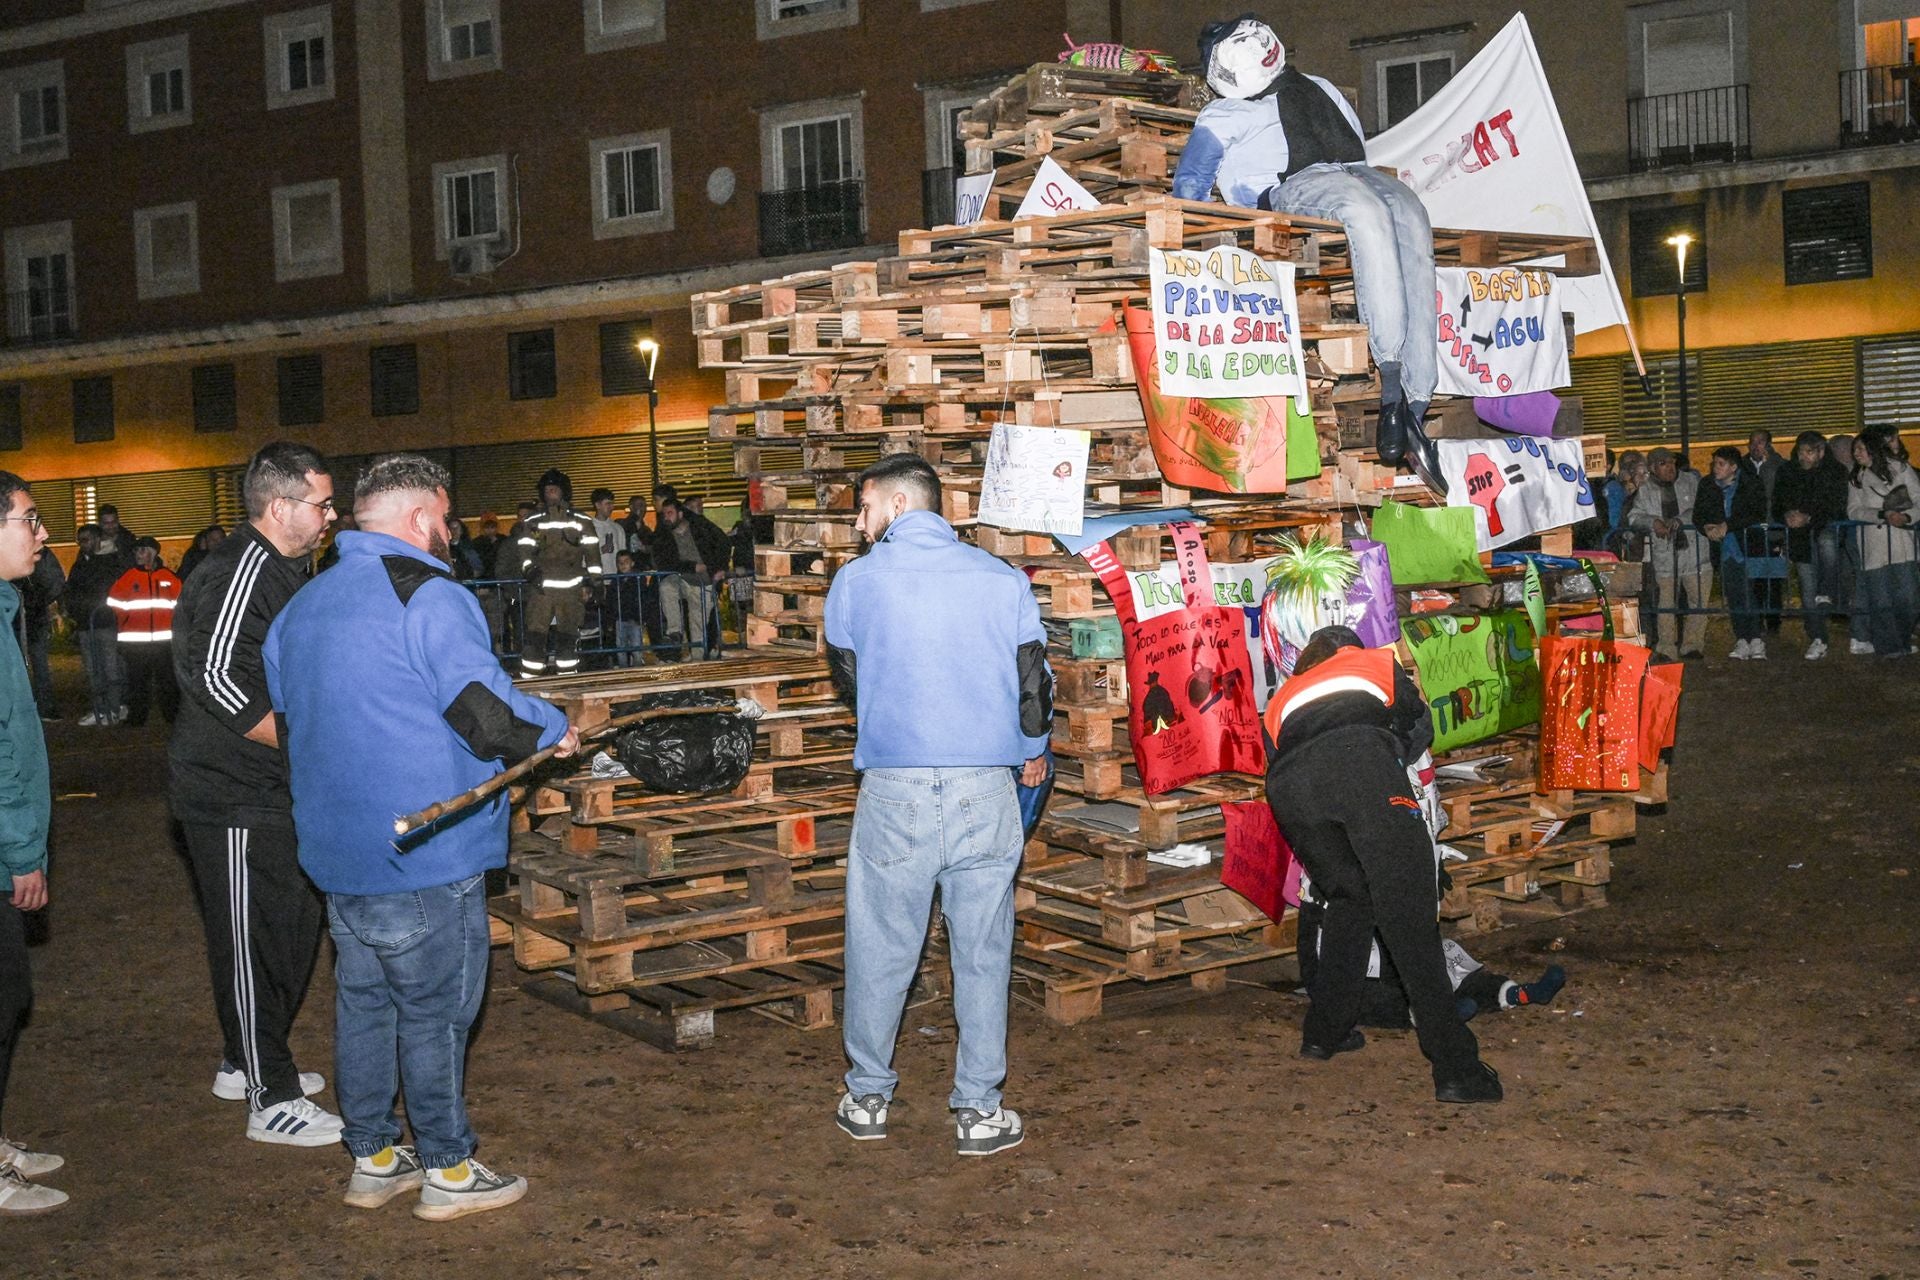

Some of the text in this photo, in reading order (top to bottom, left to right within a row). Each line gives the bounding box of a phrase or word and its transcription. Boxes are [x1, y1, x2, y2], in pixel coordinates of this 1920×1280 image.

[1162, 251, 1273, 286] NO A LA
[1467, 269, 1550, 303] BASURA
[1166, 320, 1191, 342] DE
[1198, 323, 1225, 347] LA
[1186, 353, 1213, 379] LA
[1468, 471, 1493, 496] STOP
[1173, 620, 1197, 634] QUE
[1205, 618, 1222, 628] ES
[1167, 642, 1187, 658] PARA
